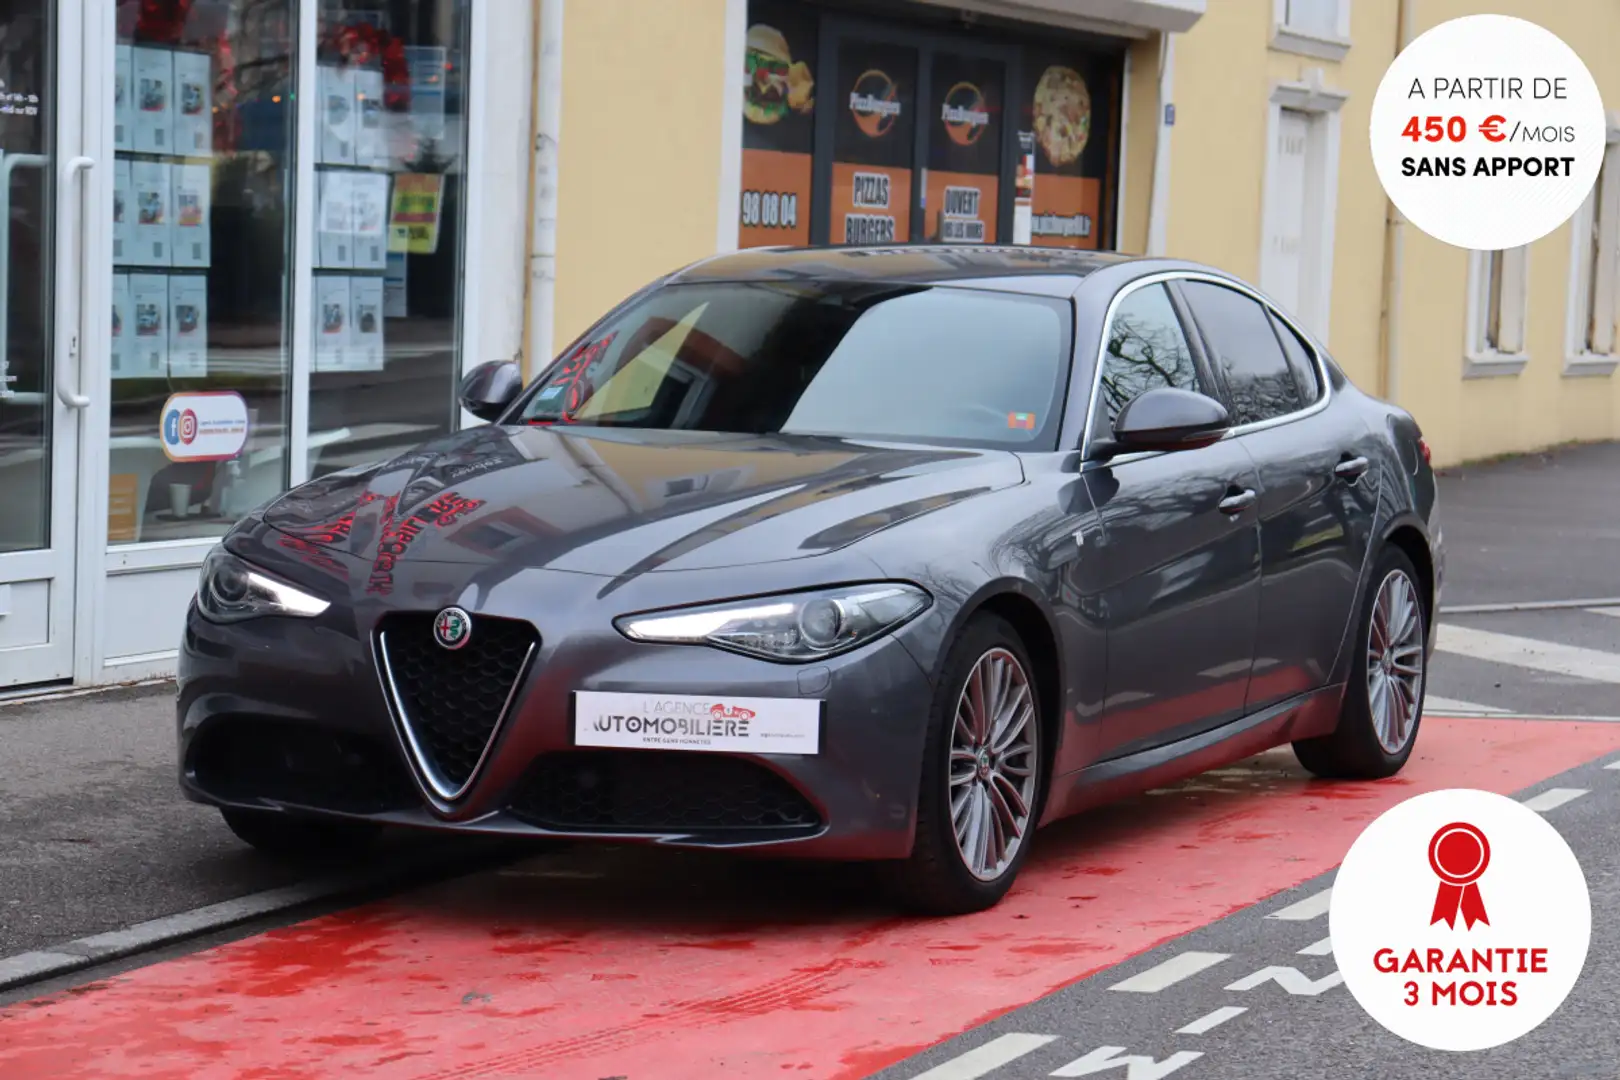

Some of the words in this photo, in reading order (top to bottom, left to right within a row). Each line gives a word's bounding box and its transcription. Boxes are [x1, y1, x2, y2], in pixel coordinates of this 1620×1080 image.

[854, 174, 889, 206] PIZZAS
[945, 188, 979, 215] OUVERT
[742, 191, 760, 227] 98
[761, 191, 779, 228] 08
[780, 193, 797, 229] 04
[846, 215, 894, 244] BURGERS
[593, 715, 749, 737] UTOMOBILIERE
